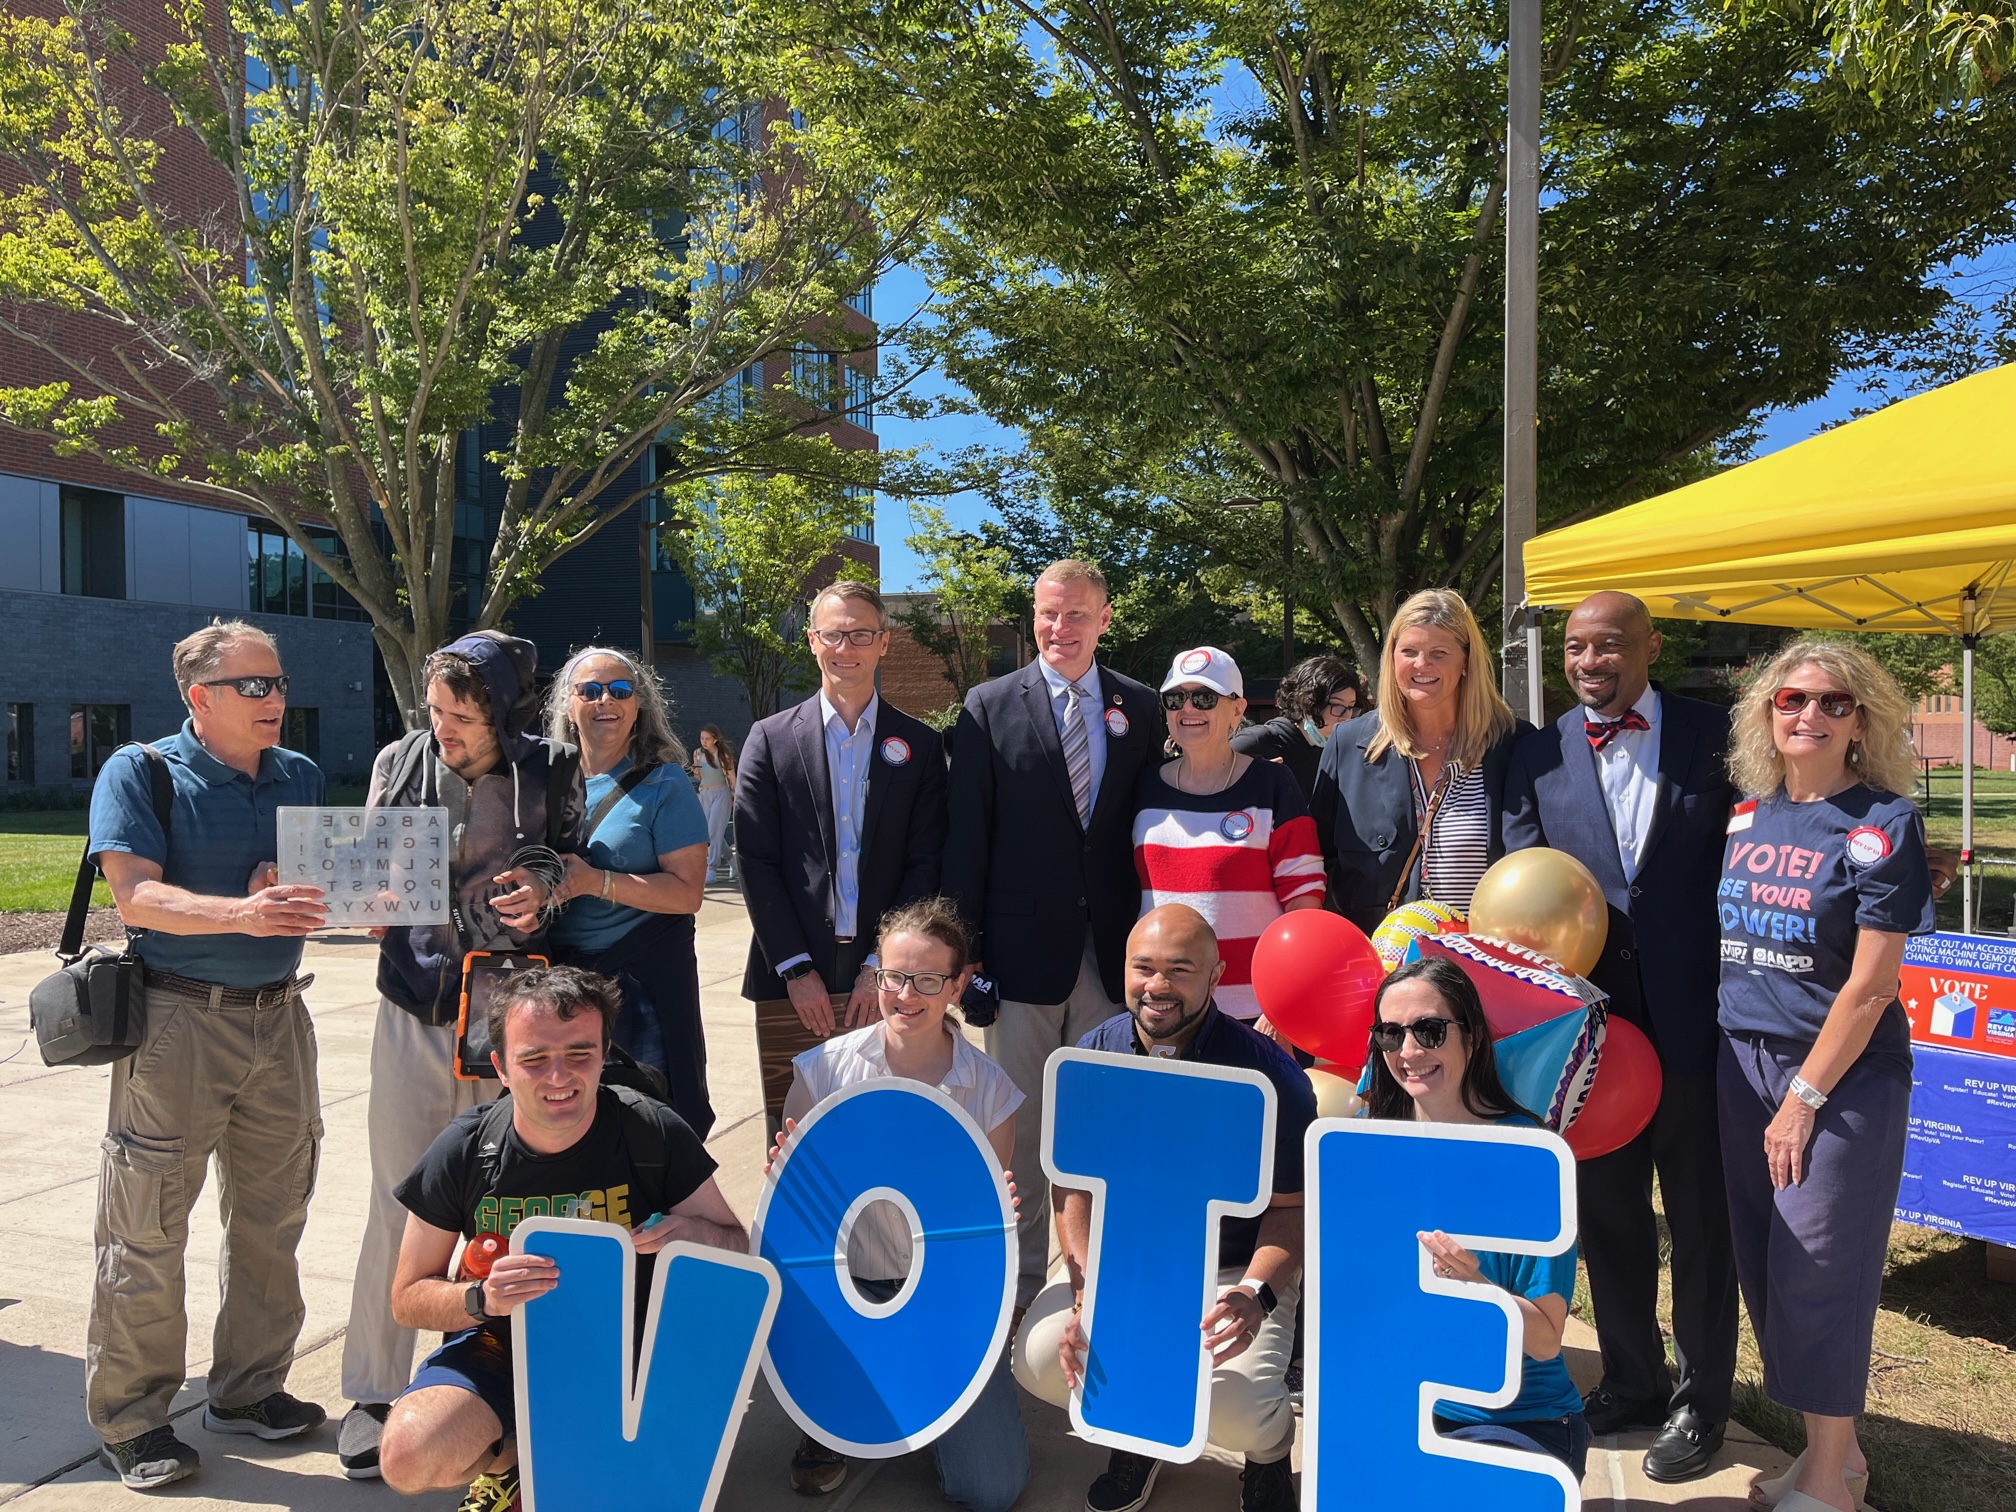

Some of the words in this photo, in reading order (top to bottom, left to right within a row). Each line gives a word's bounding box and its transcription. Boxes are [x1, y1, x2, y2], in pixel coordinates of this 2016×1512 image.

[1728, 842, 1824, 880] VOTE!
[1718, 878, 1748, 898] SE
[1751, 882, 1811, 911] YOUR
[1718, 903, 1816, 944] OWER!
[1912, 937, 1939, 947] CHECK
[1941, 940, 1960, 948] OUT
[1962, 942, 1974, 950] AN
[1767, 950, 1814, 968] AAPD
[1905, 944, 1936, 954] VOTING
[1938, 947, 1977, 960] MACHINE
[1980, 954, 2006, 963] DEMO
[1906, 952, 1939, 963] CHANCE
[1941, 956, 1953, 965] TO
[1955, 958, 1973, 967] WIN
[1982, 962, 2002, 971] GIFT
[1929, 977, 1988, 1000] VOTE
[1987, 1023, 2003, 1031] REV
[1987, 1029, 2014, 1038] VIRGINIA
[1943, 1085, 1968, 1093] Register!
[1964, 1078, 1984, 1088] REV
[1987, 1082, 1999, 1090] UP
[1909, 1117, 1922, 1125] UP
[1923, 1119, 1962, 1133] VIRGINIA
[1910, 1134, 1940, 1144] #RevUpVA
[1965, 1136, 1984, 1144] Power!
[1903, 1172, 1922, 1180] Power!
[1963, 1175, 1982, 1185] REV
[1984, 1179, 1997, 1188] UP
[1999, 1182, 2016, 1192] VIR
[1942, 1180, 1967, 1189] Register!
[1971, 1186, 1996, 1195] Educate!
[475, 1184, 632, 1239] GEORGE
[1894, 1208, 1906, 1216] EV
[1908, 1211, 1921, 1219] UP
[1923, 1213, 1962, 1229] VIRGINIA
[510, 1046, 1582, 1512] VOTE
